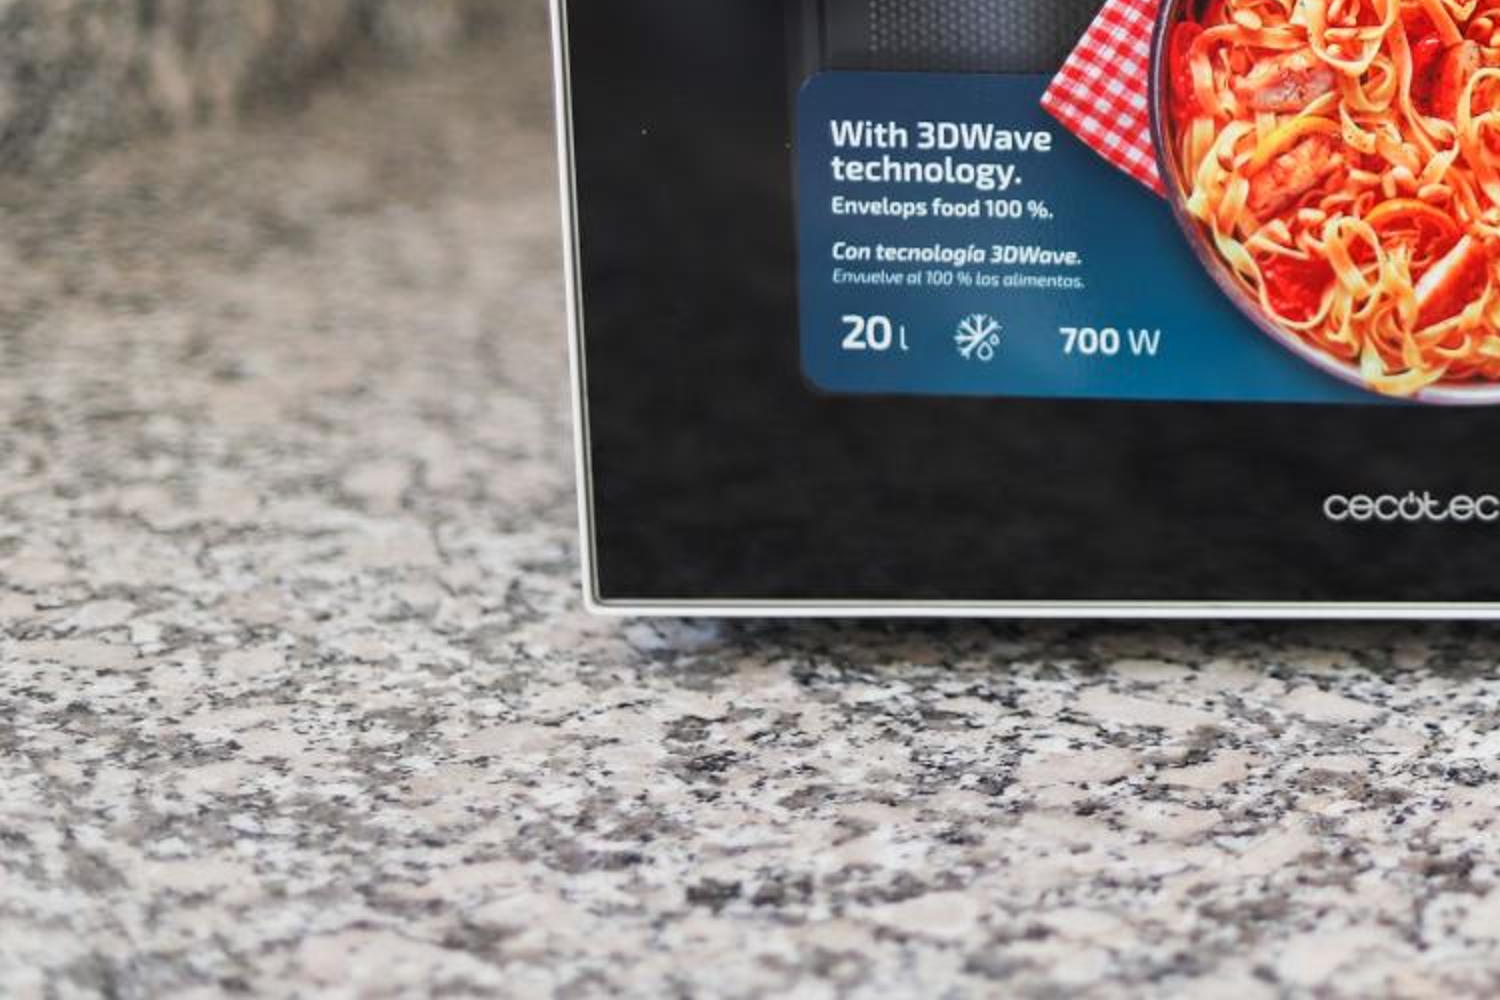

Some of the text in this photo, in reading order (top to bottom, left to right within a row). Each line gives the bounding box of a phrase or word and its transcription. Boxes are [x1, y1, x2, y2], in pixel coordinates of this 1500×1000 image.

[831, 119, 1053, 151] With 3DWave
[831, 156, 1022, 190] technology.
[832, 196, 1054, 220] Envelops food 100 %.
[832, 241, 1082, 266] Con tecnología 3DWave.
[832, 268, 1085, 289] Envuelve al 100 % los alimentos.
[841, 315, 892, 351] 20
[1059, 327, 1161, 356] 700 W
[1323, 491, 1500, 520] cecotec
